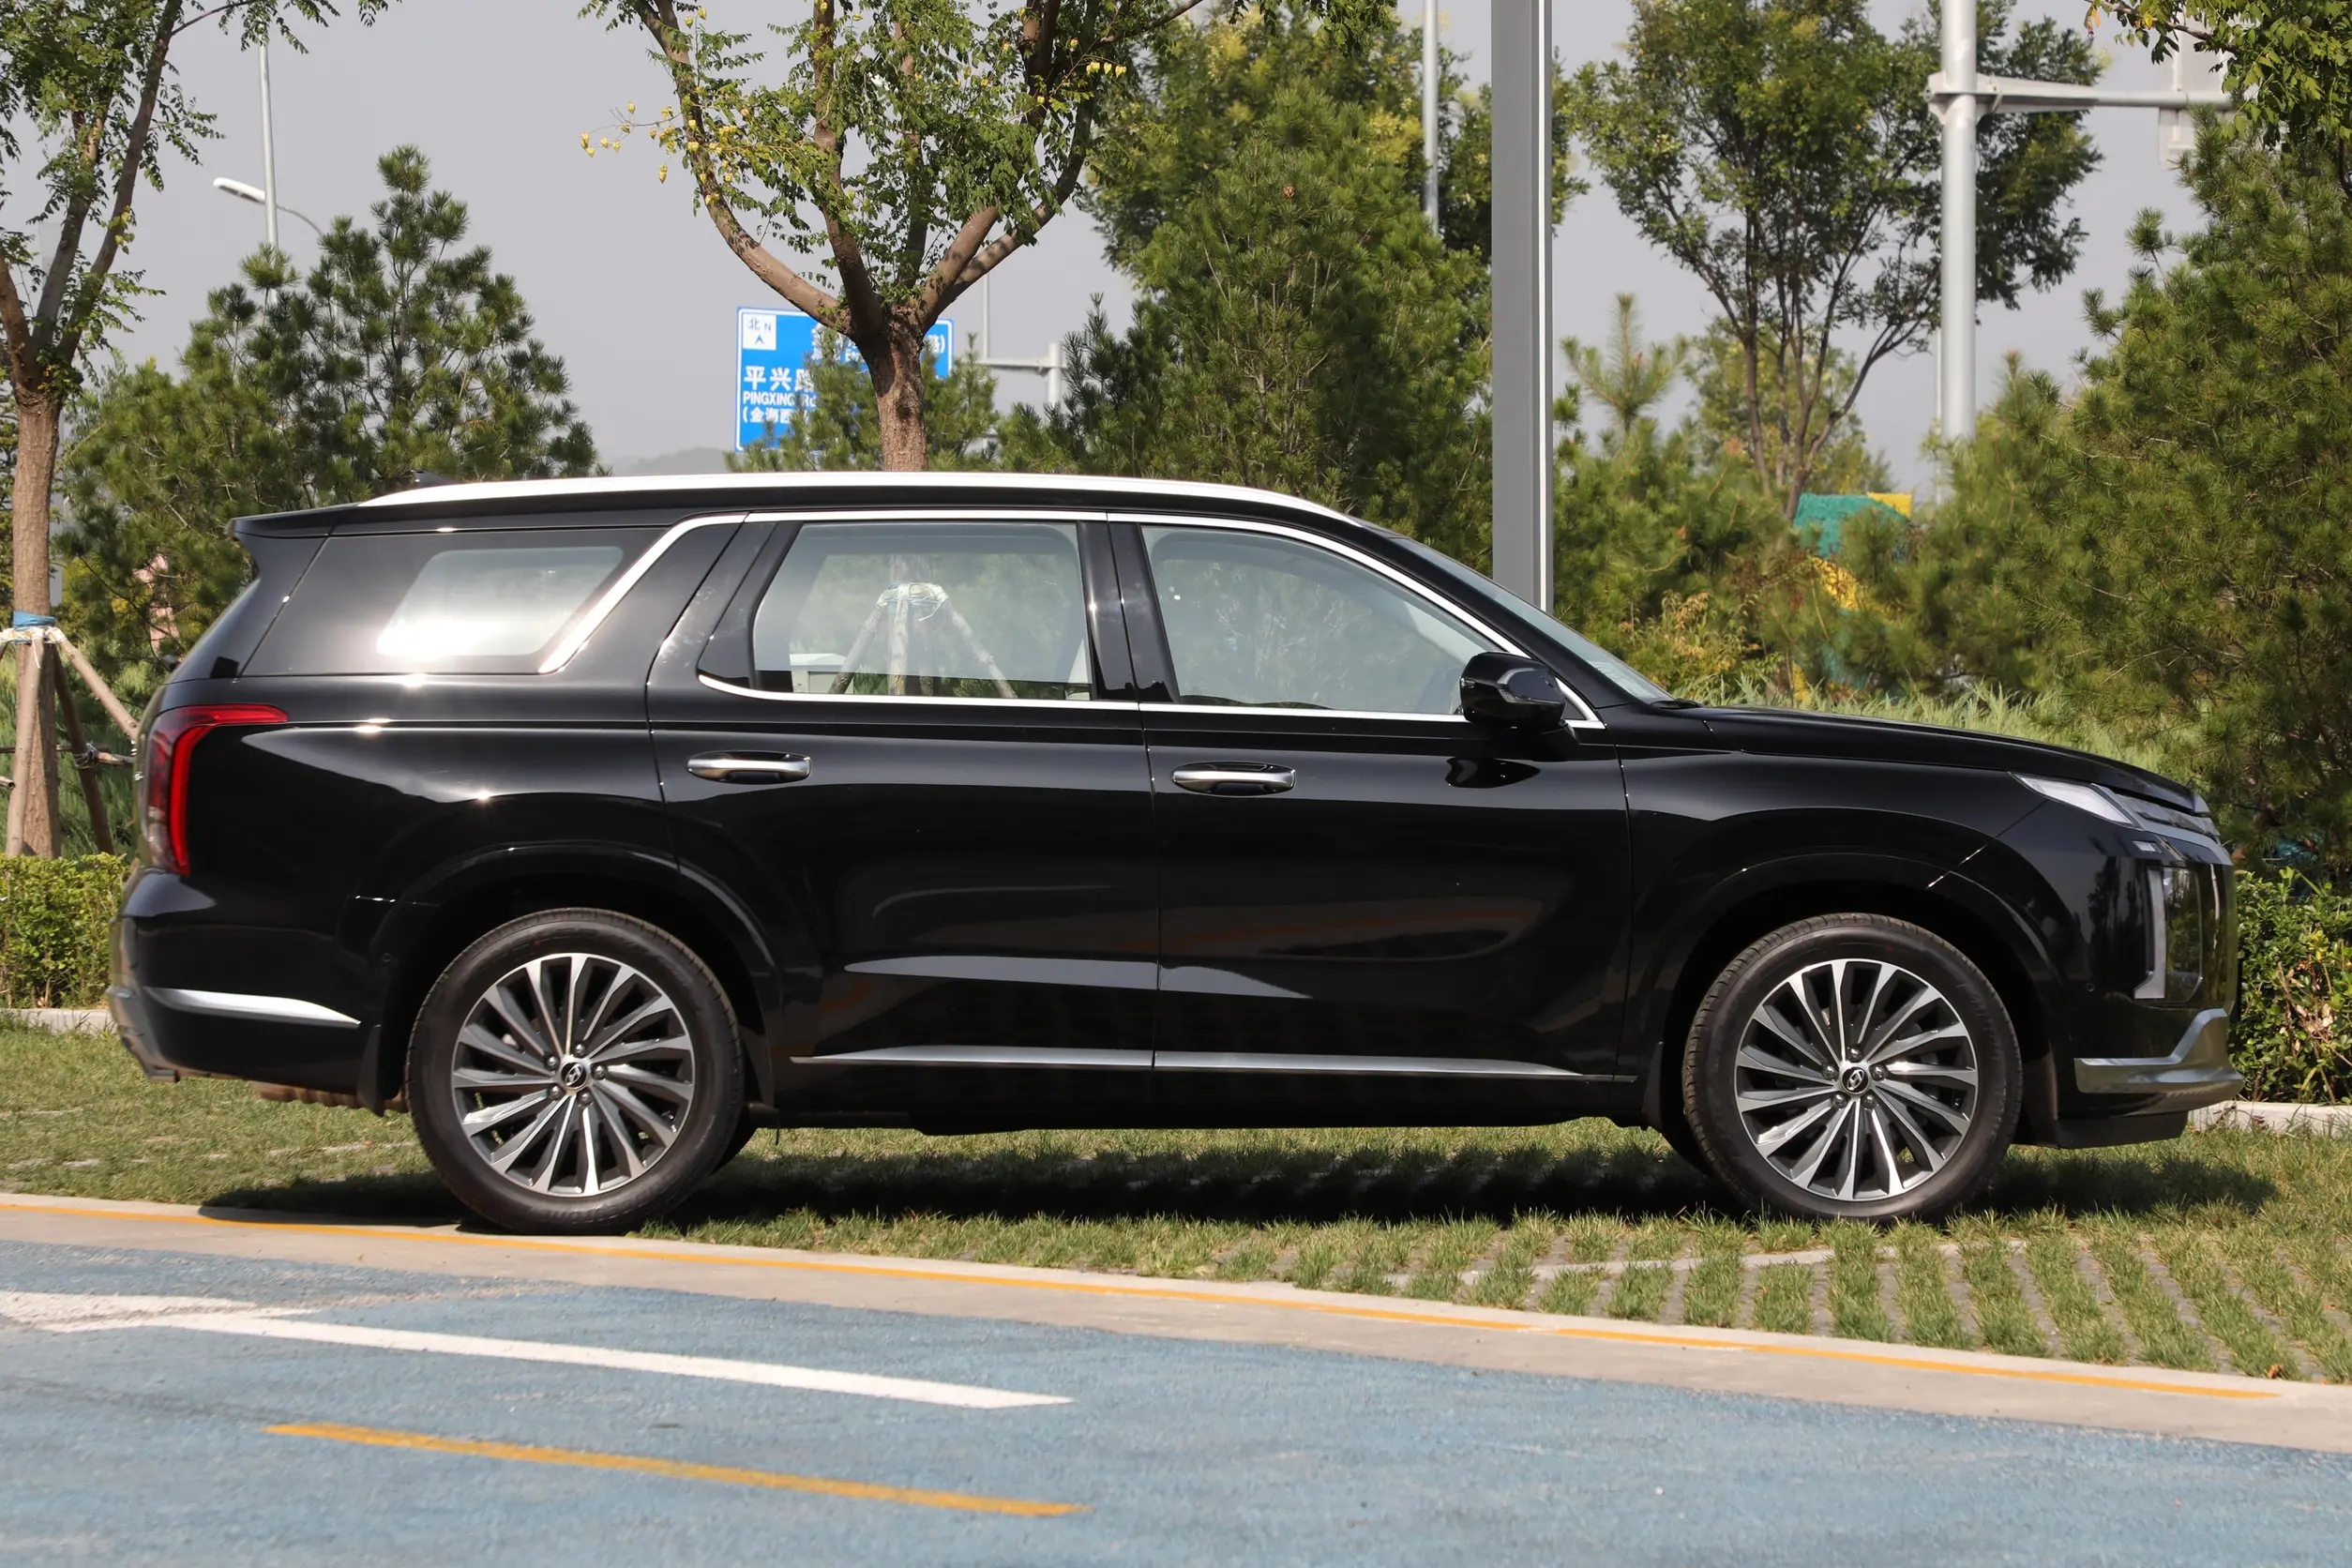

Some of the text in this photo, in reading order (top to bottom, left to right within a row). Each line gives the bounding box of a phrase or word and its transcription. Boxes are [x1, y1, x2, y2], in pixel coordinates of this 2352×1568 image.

[748, 318, 772, 331] 北 N
[744, 391, 795, 407] PINGXING
